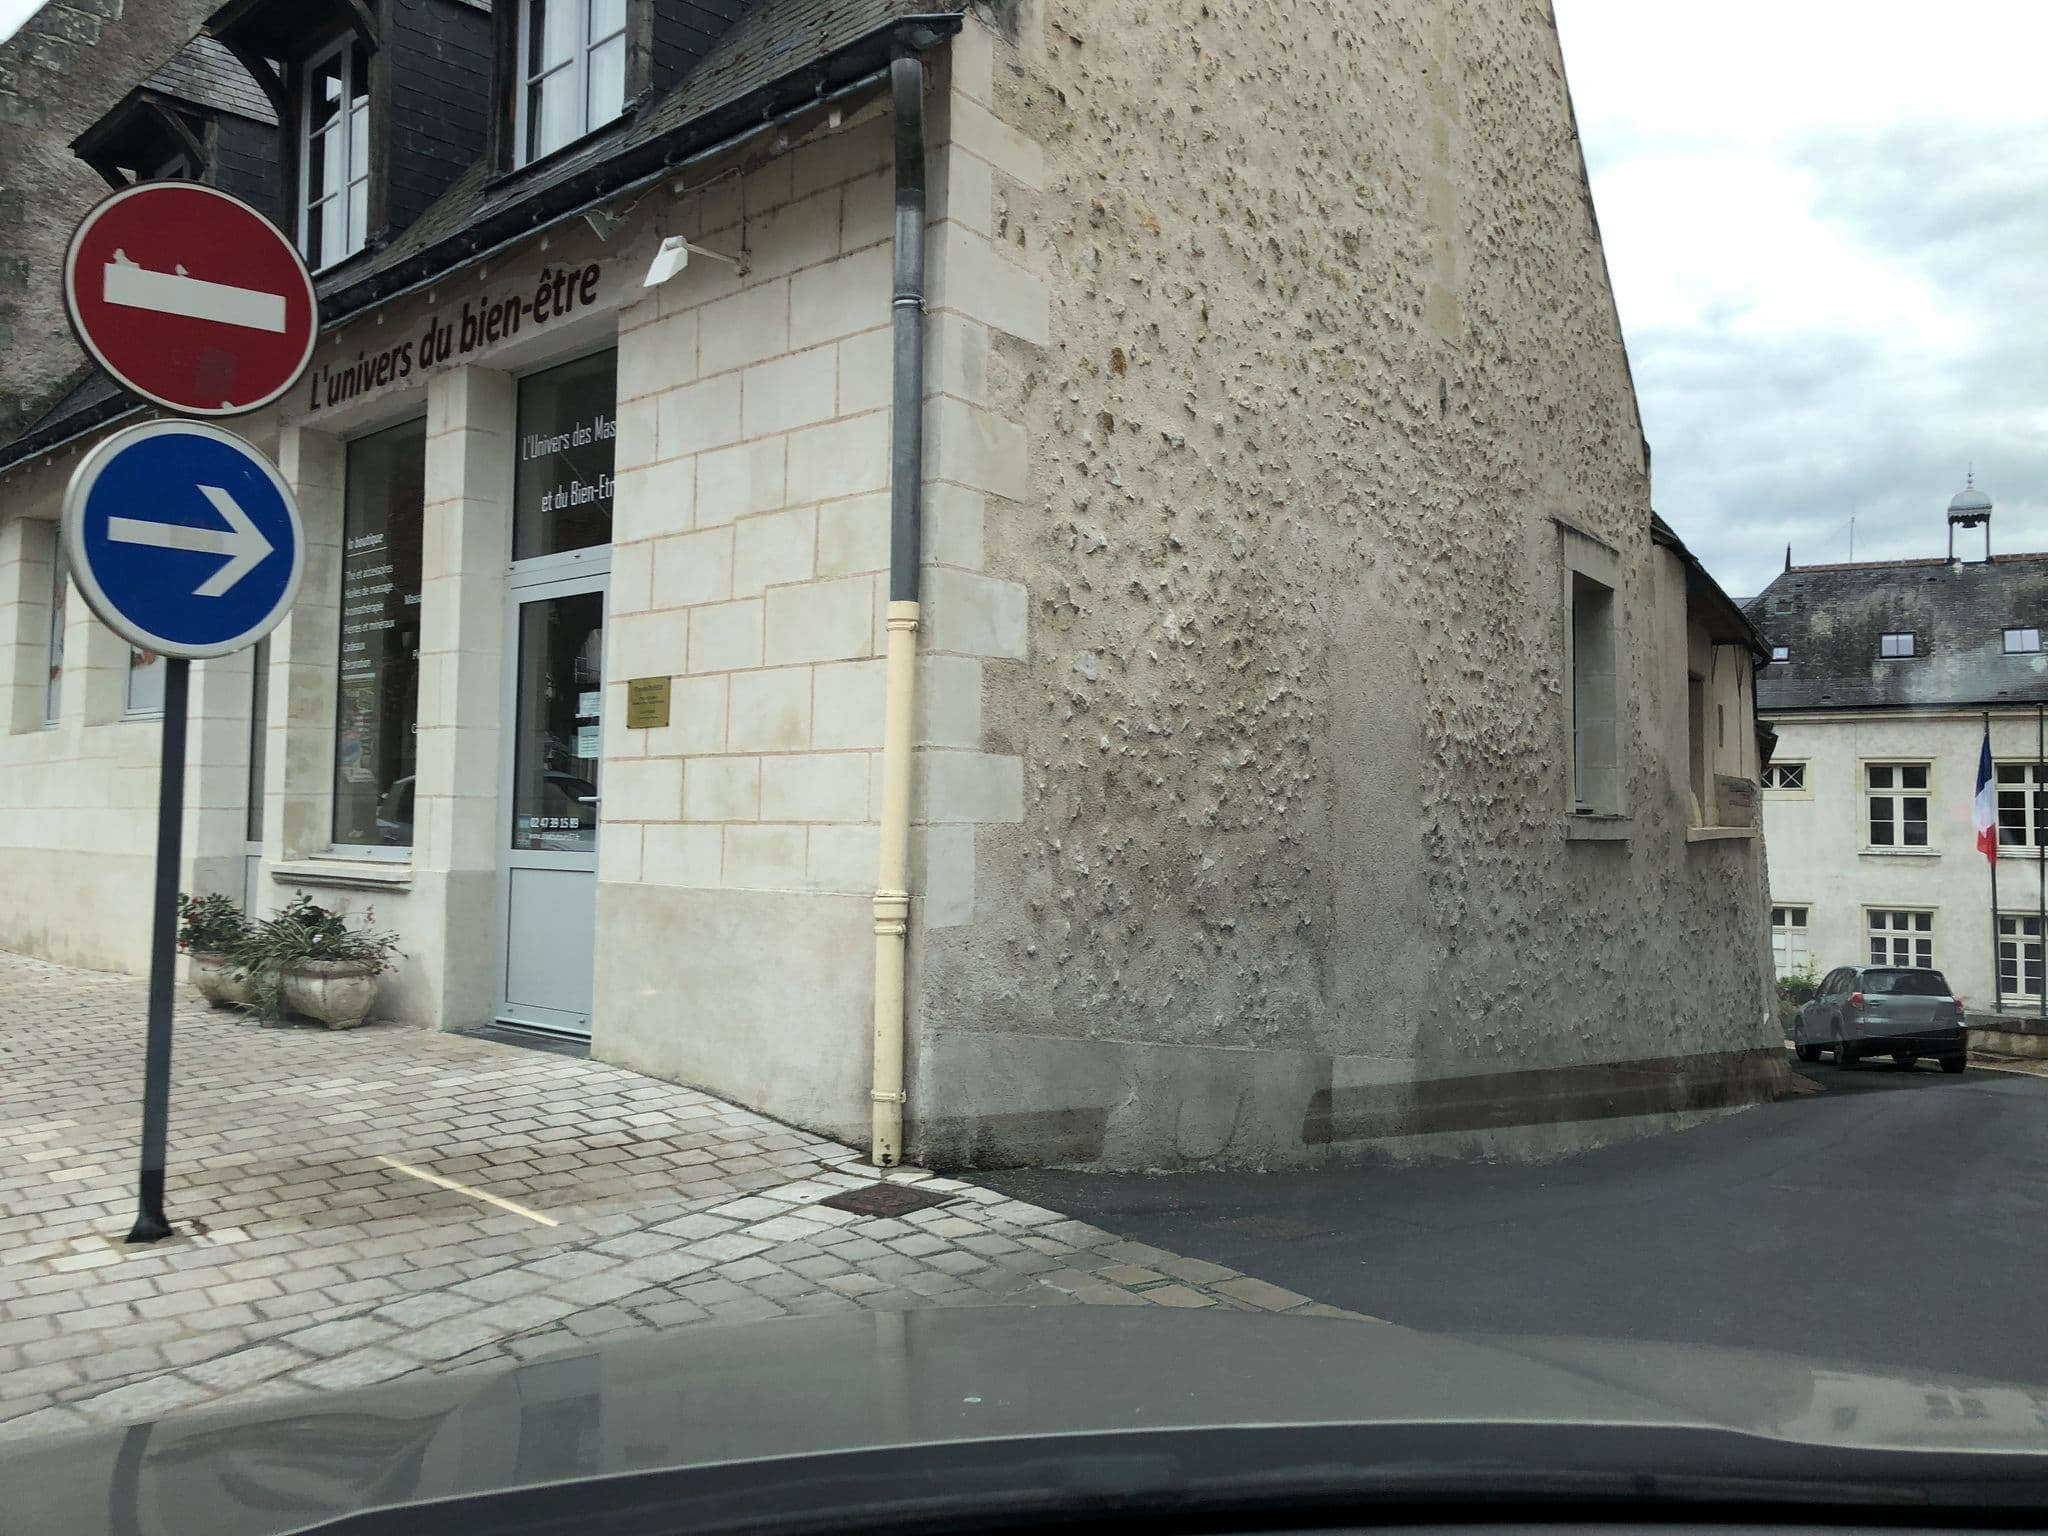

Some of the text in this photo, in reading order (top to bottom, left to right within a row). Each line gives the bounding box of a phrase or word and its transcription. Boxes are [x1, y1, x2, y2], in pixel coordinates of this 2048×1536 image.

[309, 263, 600, 411] L'univers du bien-être
[522, 433, 570, 460] L'Univers
[572, 421, 592, 447] des
[541, 491, 552, 512] et
[555, 484, 568, 509] du
[530, 817, 540, 828] 02
[540, 817, 549, 828] 47
